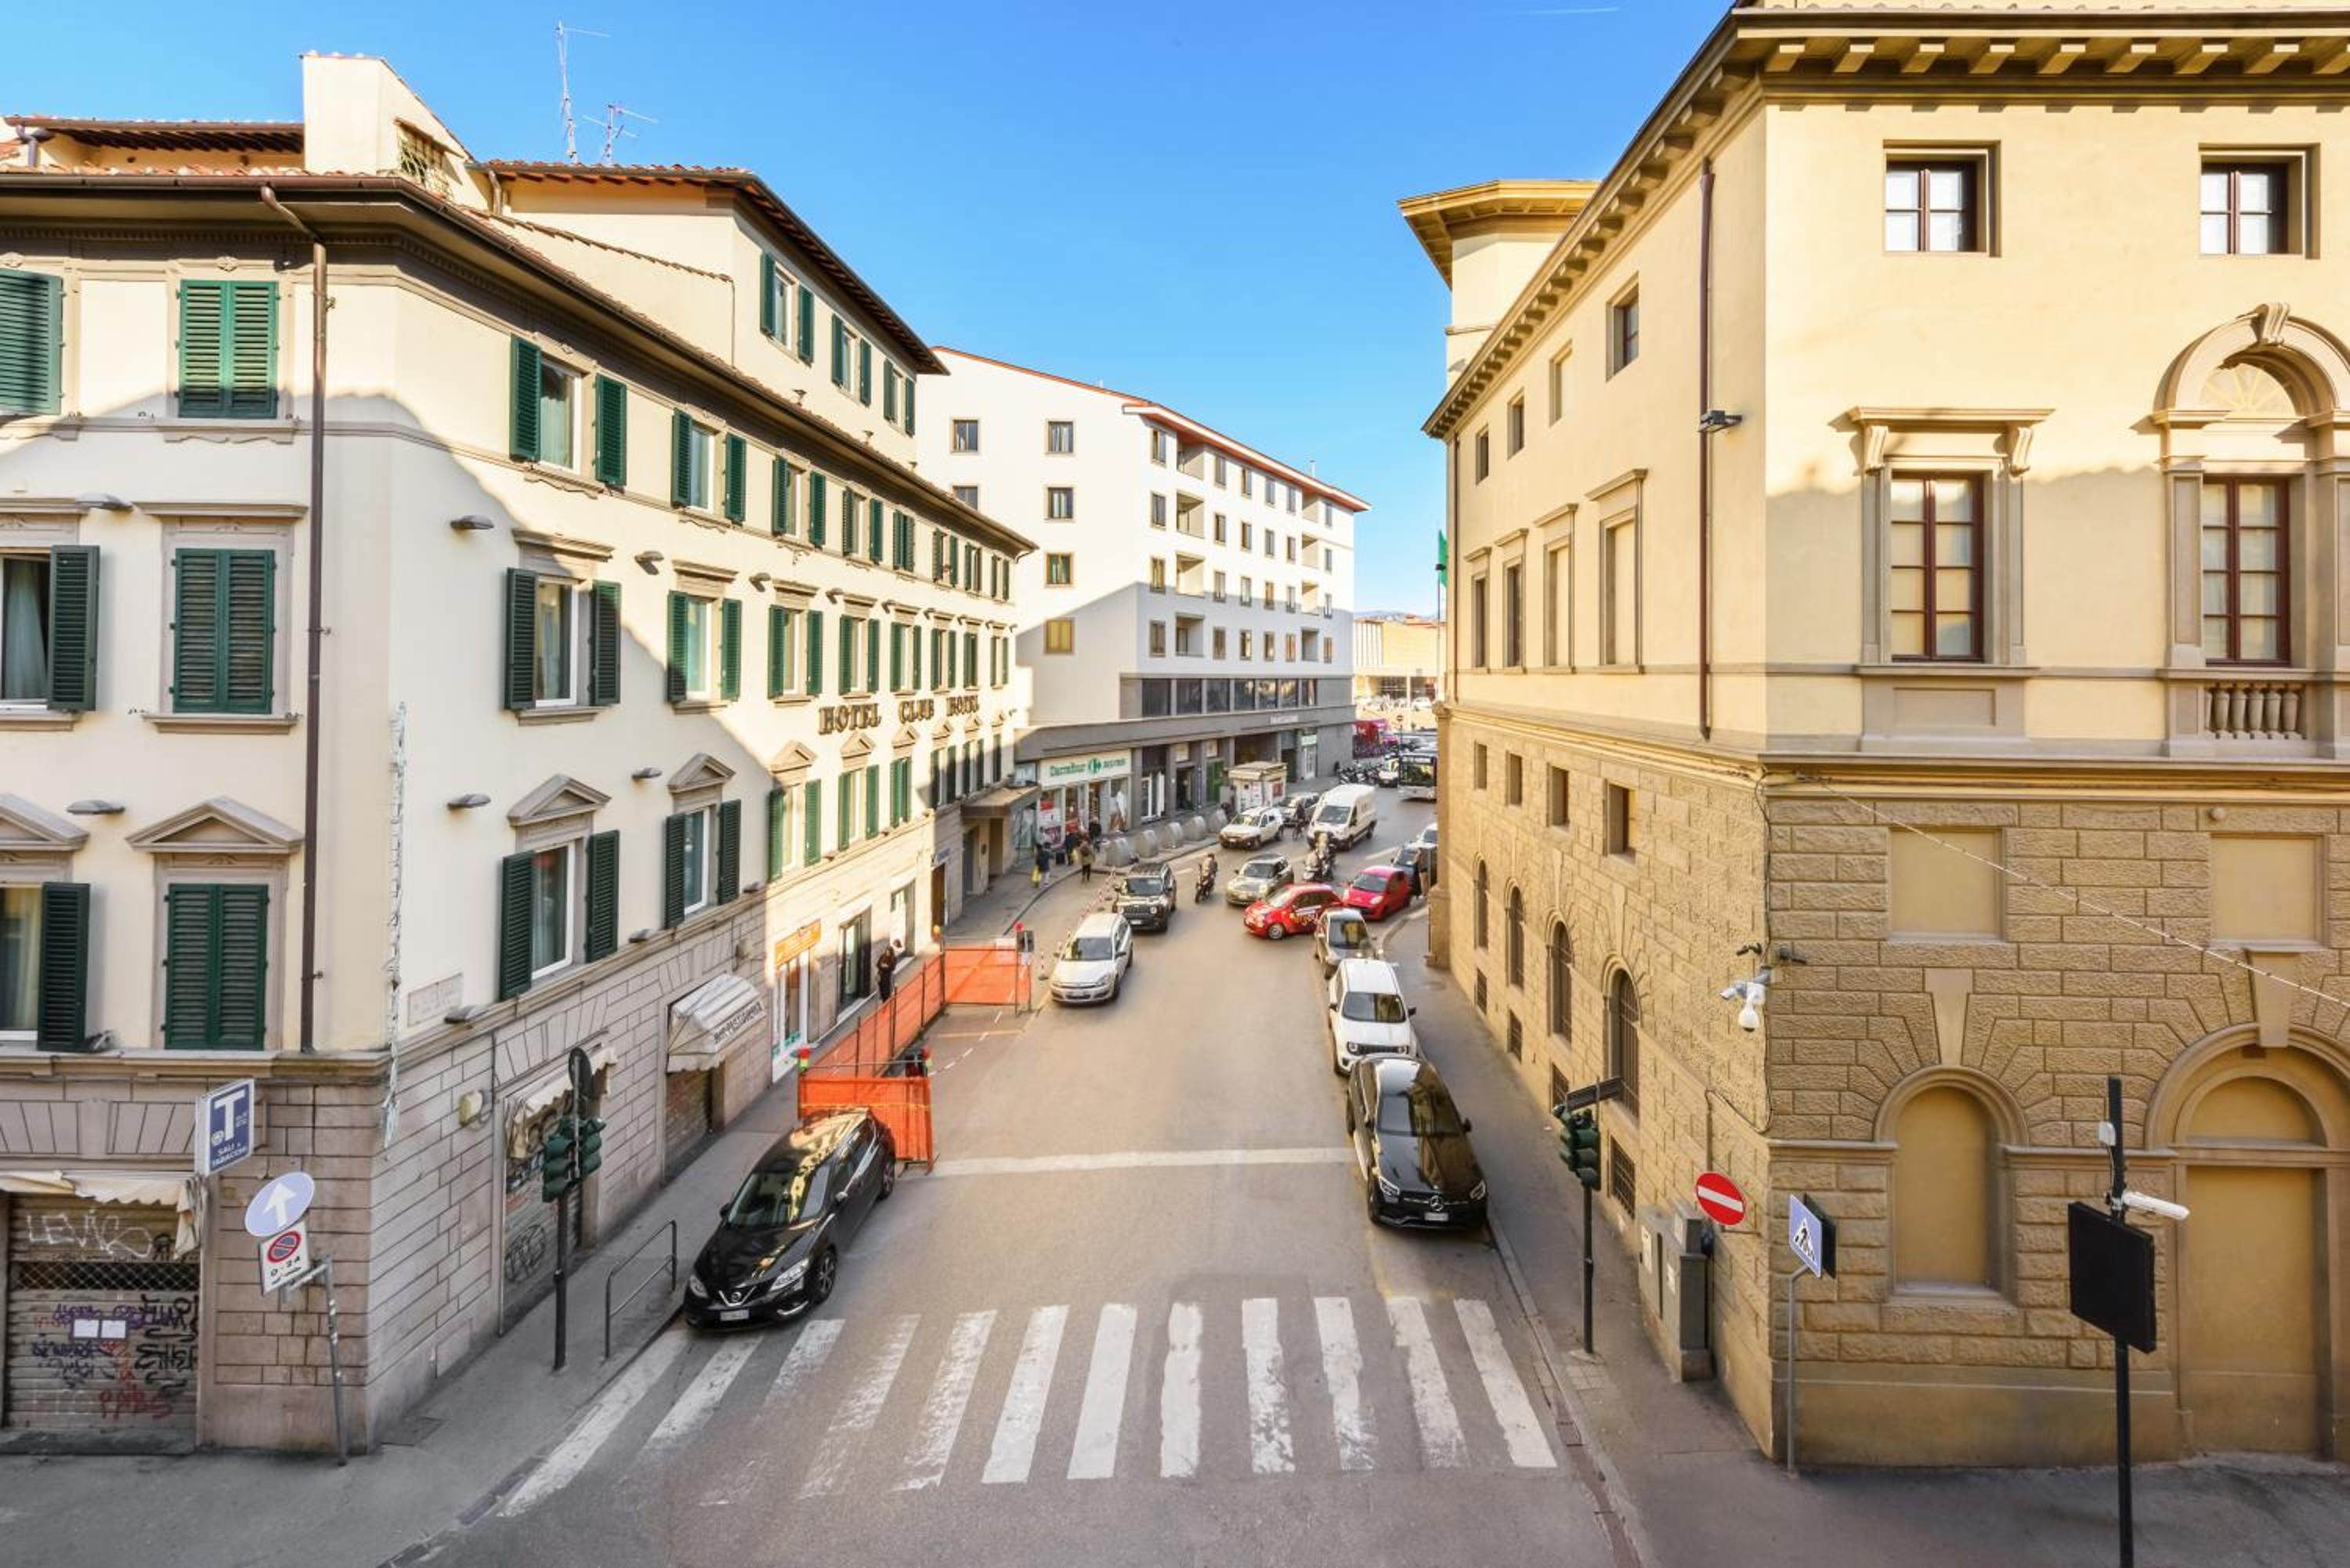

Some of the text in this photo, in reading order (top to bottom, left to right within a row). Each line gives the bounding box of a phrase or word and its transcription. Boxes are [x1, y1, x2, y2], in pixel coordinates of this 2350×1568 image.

[819, 703, 882, 735] HOTEL
[898, 699, 934, 724] CLUB
[214, 1089, 245, 1141] T
